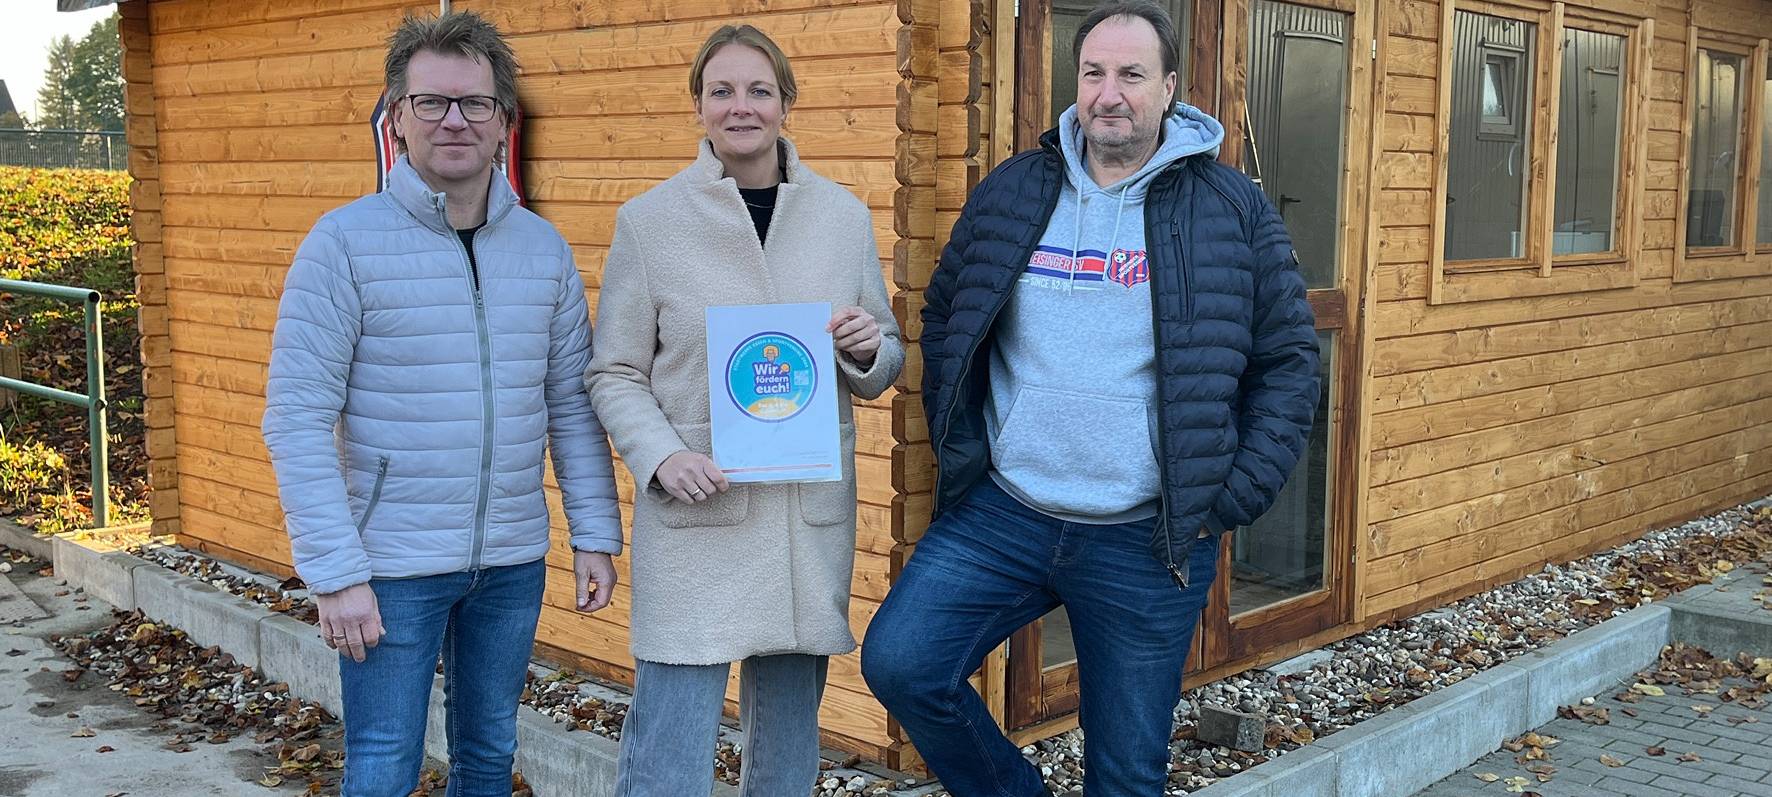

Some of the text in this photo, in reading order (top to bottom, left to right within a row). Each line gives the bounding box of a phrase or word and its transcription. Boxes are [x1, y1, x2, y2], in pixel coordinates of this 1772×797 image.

[1030, 277, 1049, 288] SINCE
[754, 363, 779, 375] Wir
[755, 375, 789, 384] fördern
[755, 382, 790, 394] euch!
